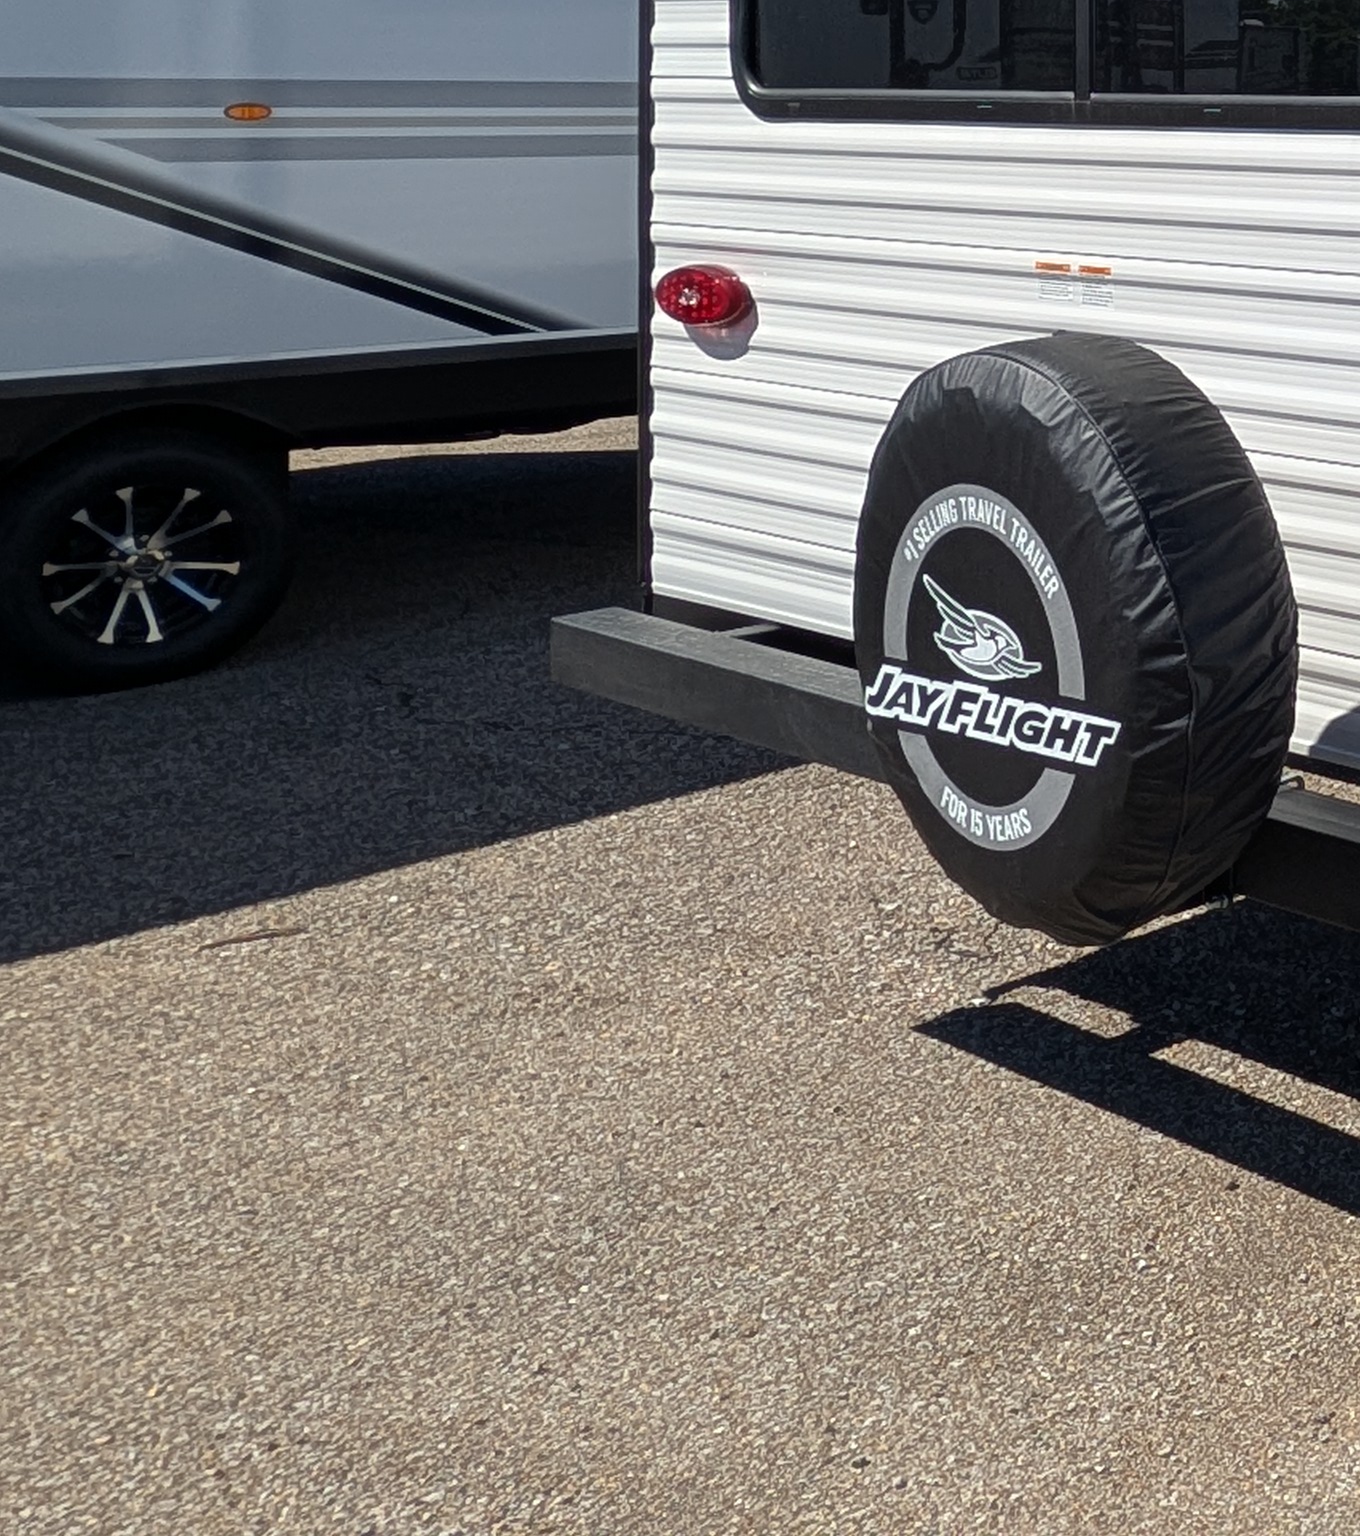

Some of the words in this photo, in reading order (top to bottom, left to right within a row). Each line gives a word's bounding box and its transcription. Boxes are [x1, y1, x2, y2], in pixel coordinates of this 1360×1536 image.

[903, 539, 919, 561] #1
[912, 498, 958, 551] SELLING
[959, 496, 1007, 535] TRAVEL
[1011, 517, 1060, 600] TRAILER
[941, 785, 968, 828] FOR
[970, 809, 983, 836] 15
[985, 808, 1032, 841] YEARS
